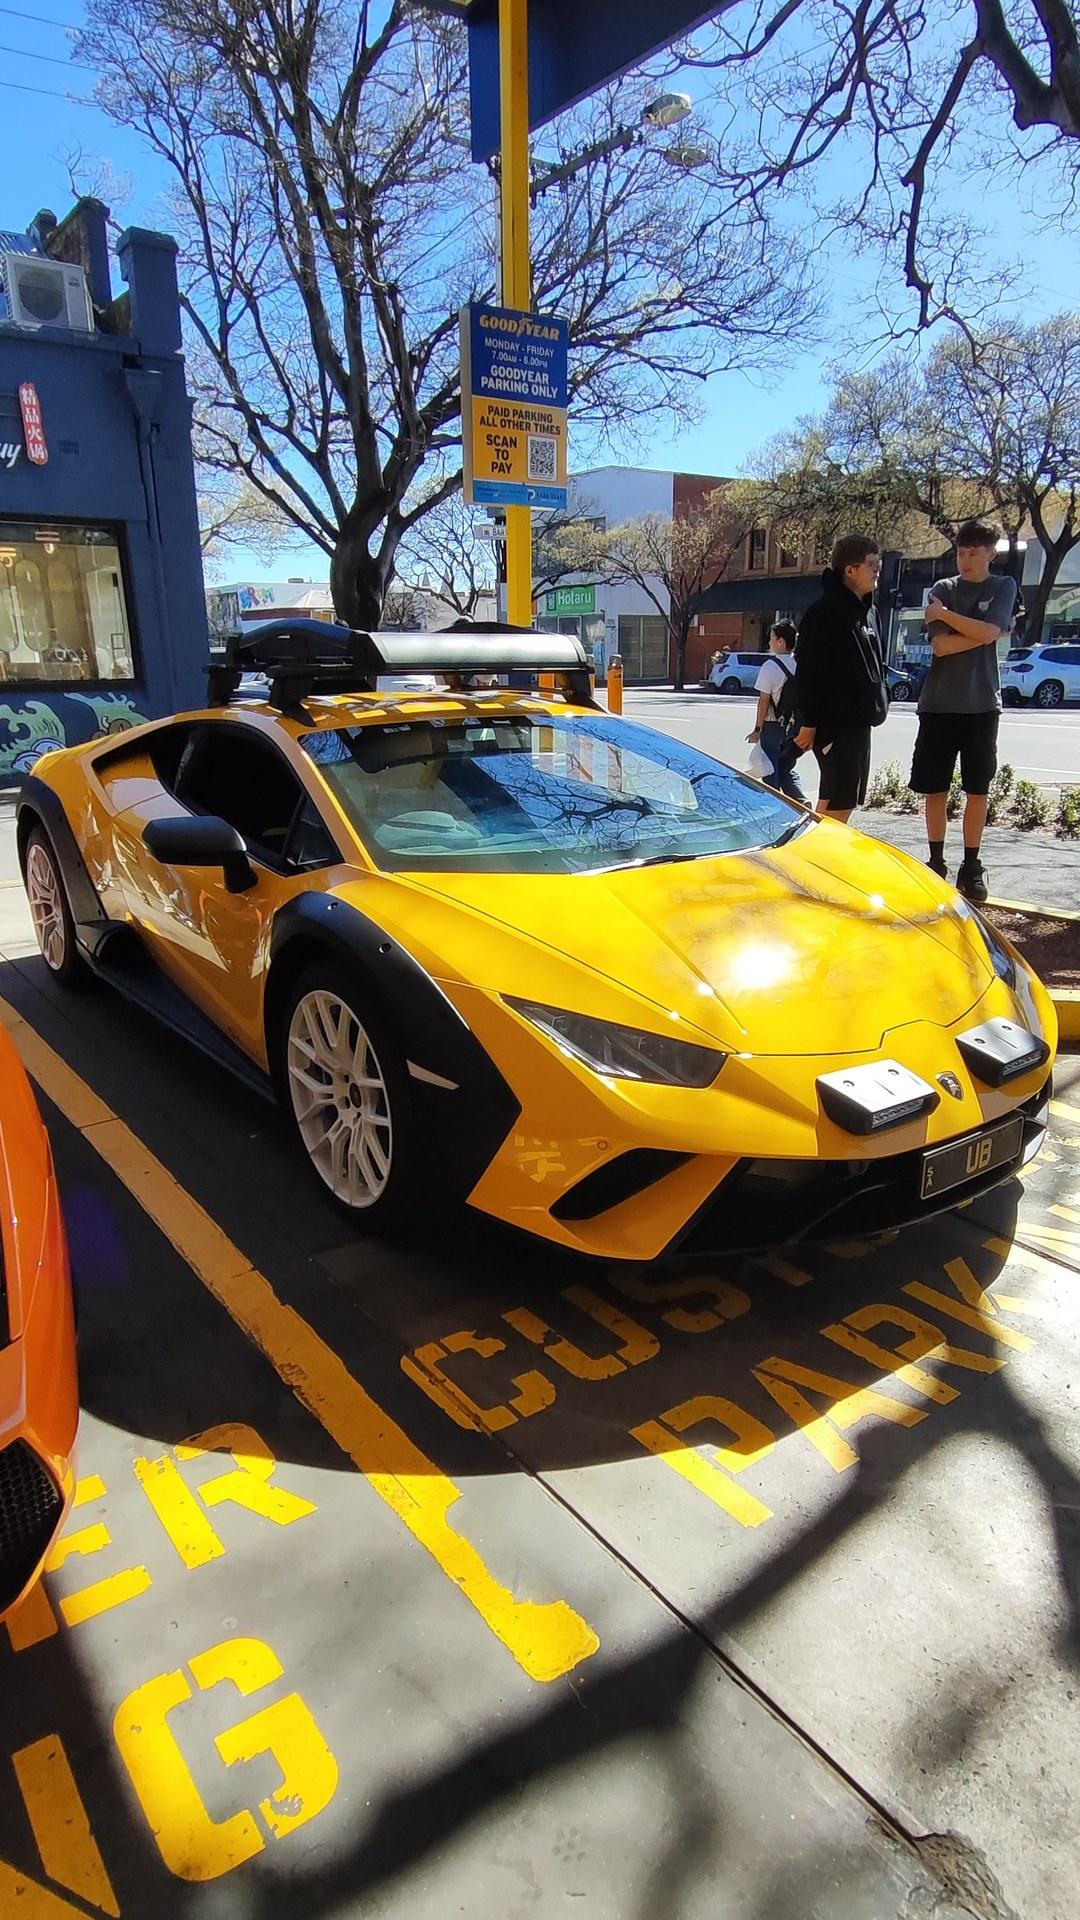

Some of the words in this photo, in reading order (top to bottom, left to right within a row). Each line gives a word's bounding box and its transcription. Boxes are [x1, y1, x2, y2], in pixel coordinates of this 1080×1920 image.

[479, 314, 560, 340] GOODYEAR
[484, 336, 520, 352] MONDAY
[526, 345, 555, 358] FRIDAY
[490, 364, 549, 385] GOODYEAR
[480, 376, 529, 395] PARKING
[531, 383, 558, 399] ONLY
[487, 405, 510, 418] PAID
[512, 408, 553, 424] PARKING
[479, 415, 498, 428] ALL
[500, 418, 531, 432] OTHER
[533, 422, 561, 435] TIMES
[486, 433, 518, 448] SCAN
[494, 448, 510, 461] TO
[490, 461, 513, 474] PAY
[557, 590, 592, 605] Hotaru
[965, 1138, 994, 1174] UB
